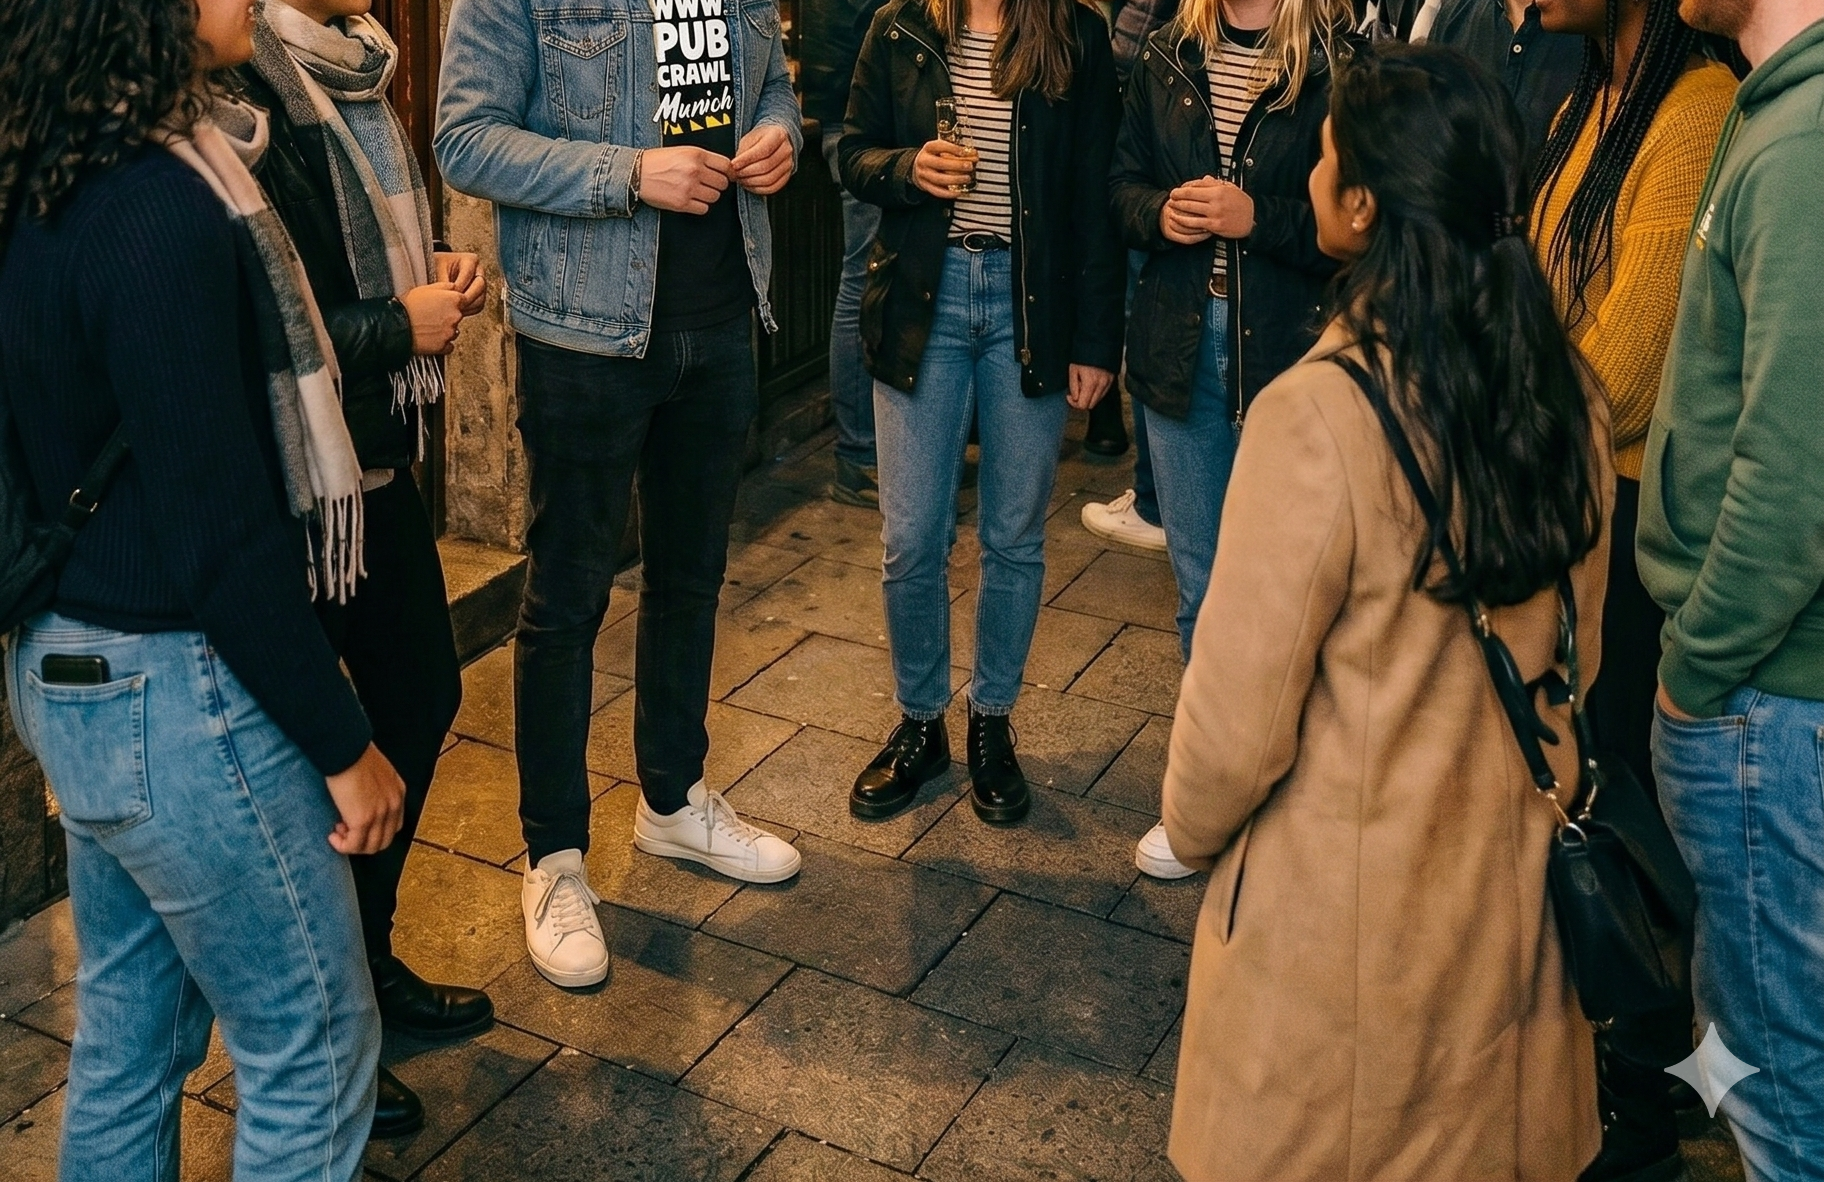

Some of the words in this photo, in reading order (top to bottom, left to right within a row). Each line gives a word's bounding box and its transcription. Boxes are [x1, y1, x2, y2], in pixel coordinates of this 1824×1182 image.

[652, 18, 730, 64] PUB
[657, 59, 732, 89] CRAWL
[652, 85, 735, 124] Munich
